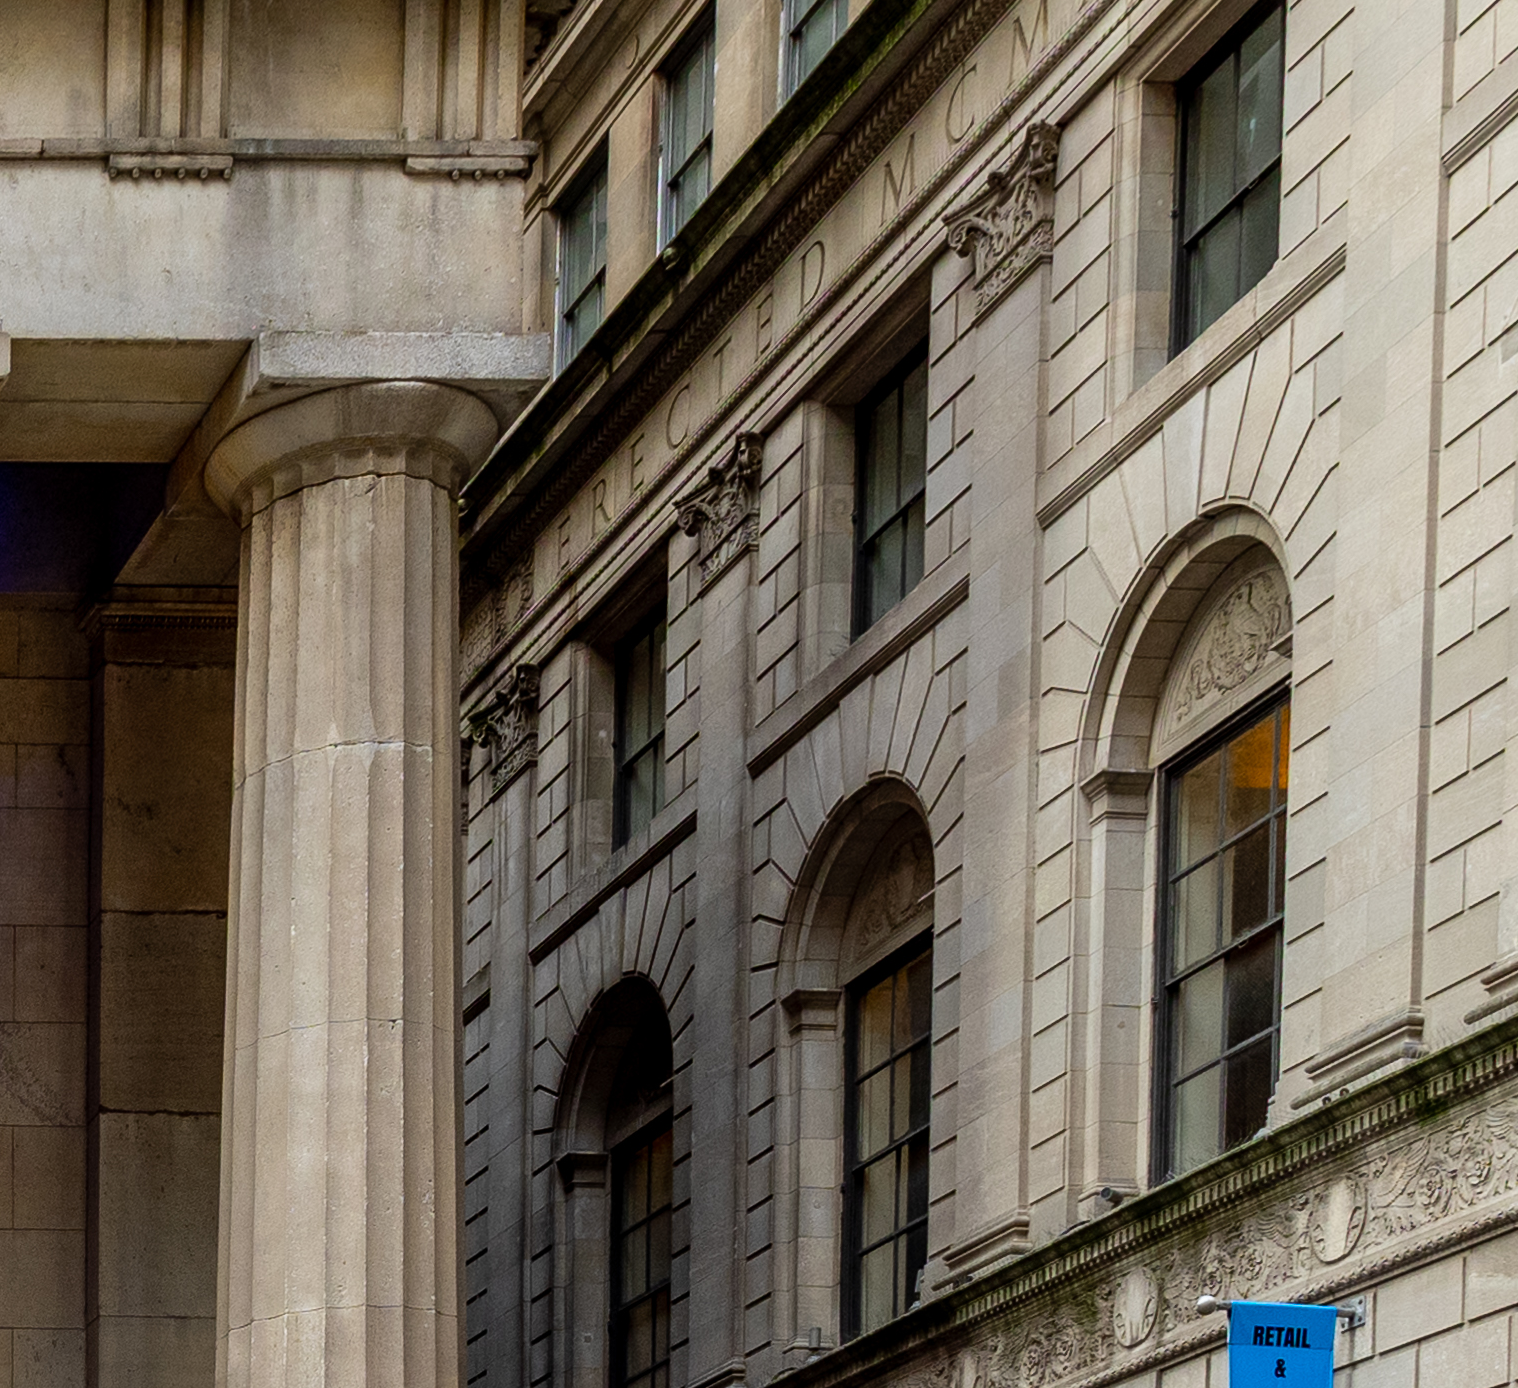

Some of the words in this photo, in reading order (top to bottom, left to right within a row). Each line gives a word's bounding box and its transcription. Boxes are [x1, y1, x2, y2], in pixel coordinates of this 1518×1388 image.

[558, 240, 826, 570] ERECTED
[1252, 1325, 1311, 1348] RETAIL
[1274, 1358, 1287, 1378] &
